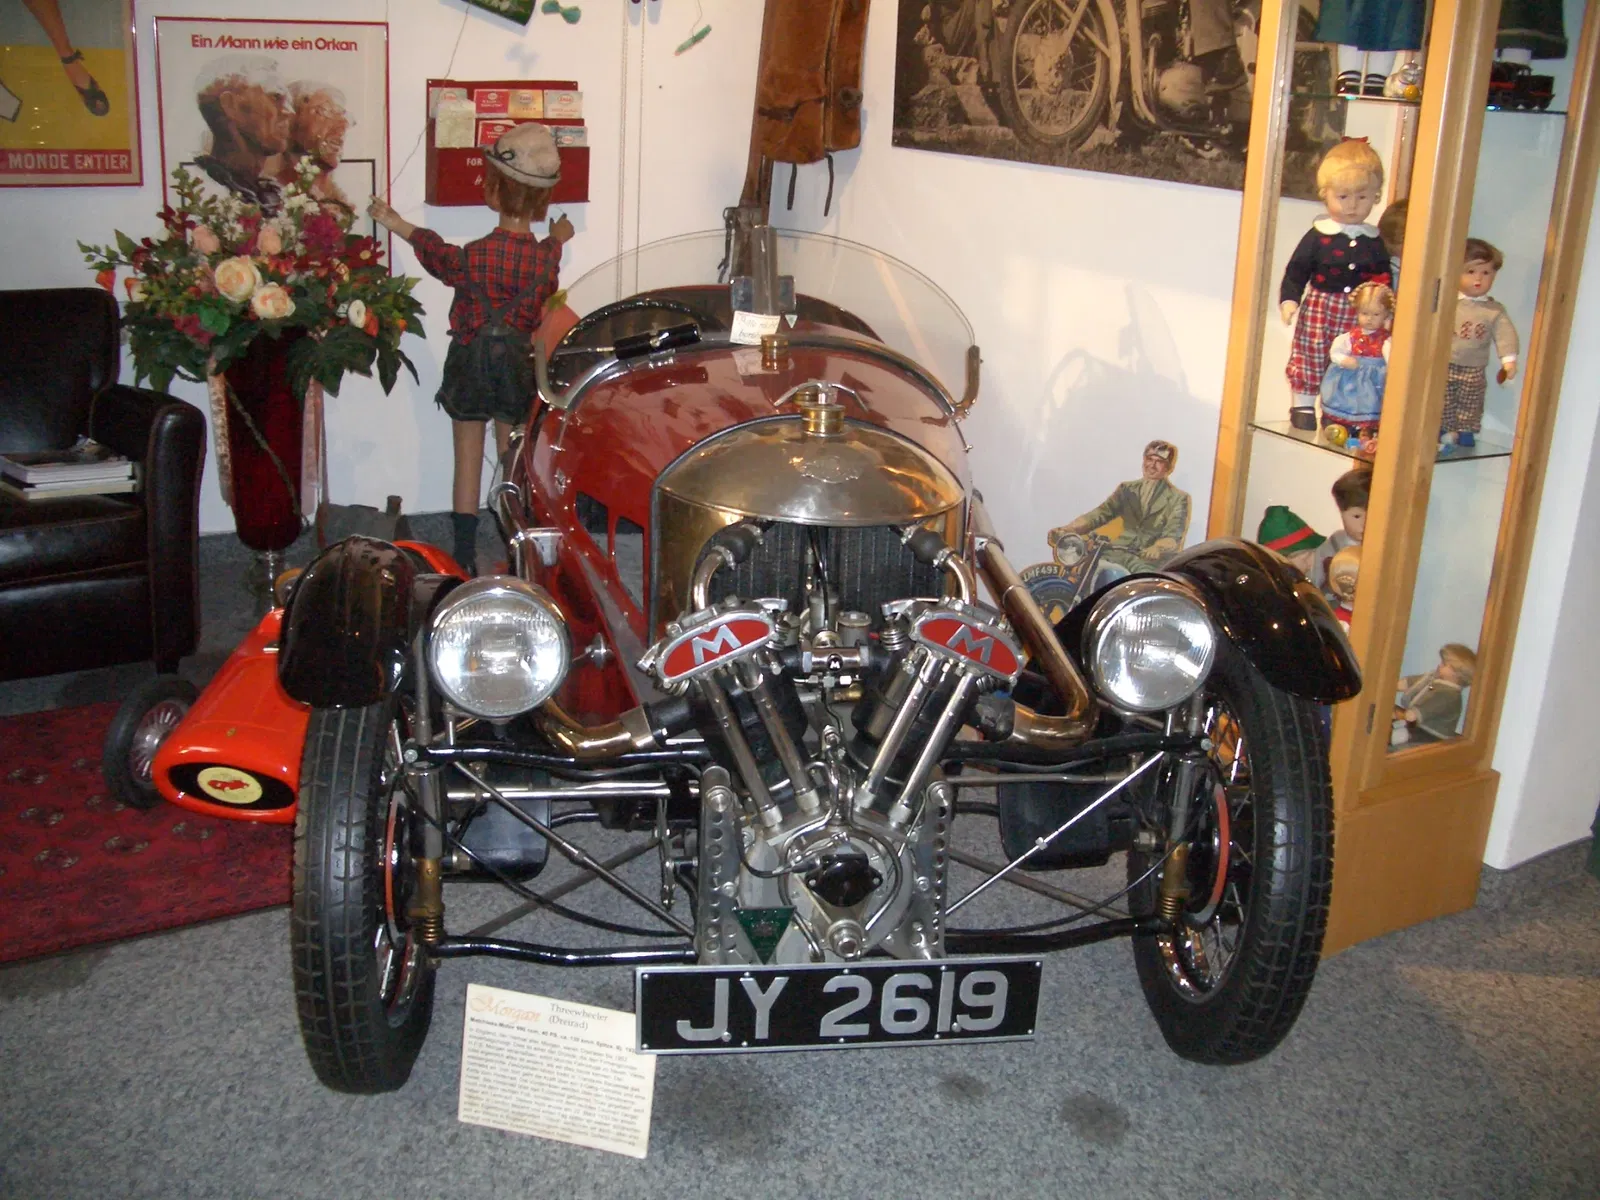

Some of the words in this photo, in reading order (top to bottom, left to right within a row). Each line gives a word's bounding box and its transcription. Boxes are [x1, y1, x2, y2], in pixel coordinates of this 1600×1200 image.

[191, 34, 212, 48] Ein
[214, 35, 261, 49] Mann
[264, 37, 289, 50] wie
[292, 37, 313, 50] ein
[315, 37, 358, 51] Orkan
[7, 152, 70, 169] MONDE
[74, 153, 129, 170] ENTIER
[691, 624, 742, 666] M
[945, 624, 995, 664] M
[470, 995, 541, 1024] Morgan
[549, 1002, 608, 1021] Threewheeler
[676, 977, 789, 1042] JY
[819, 970, 1009, 1037] 2619
